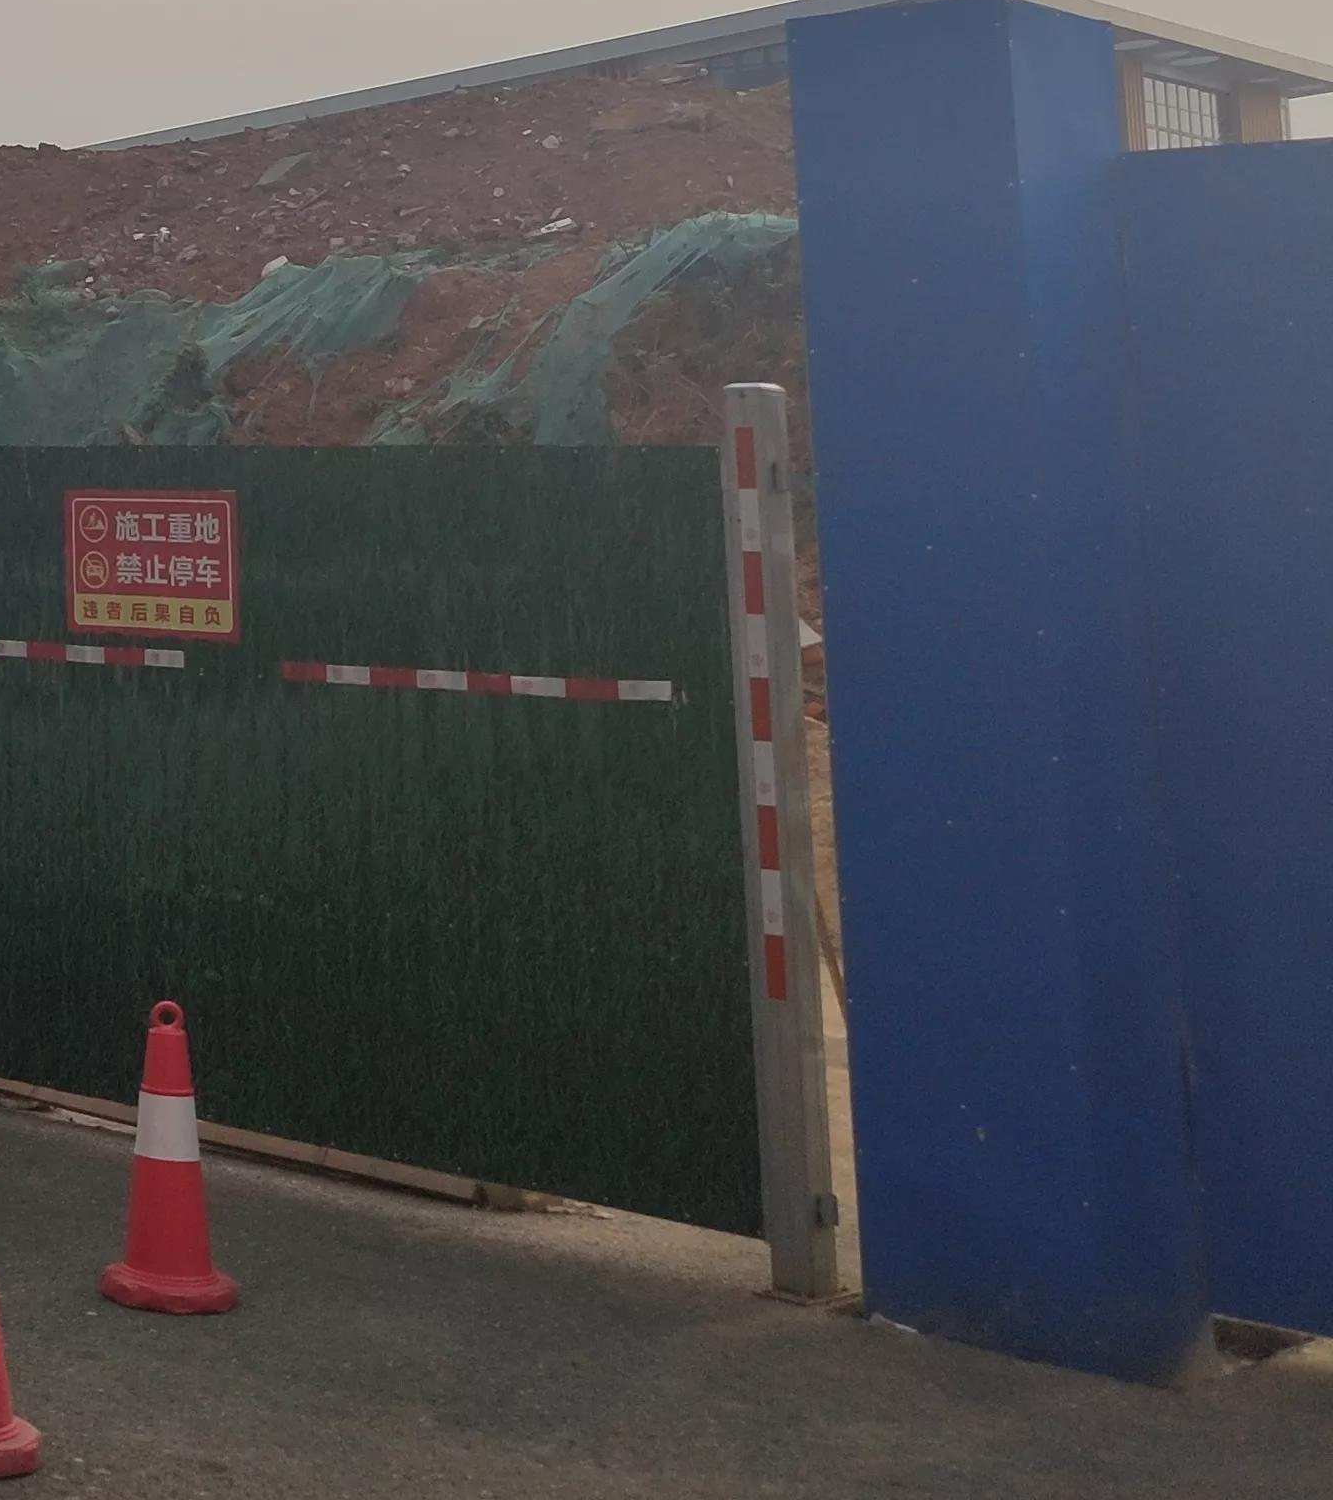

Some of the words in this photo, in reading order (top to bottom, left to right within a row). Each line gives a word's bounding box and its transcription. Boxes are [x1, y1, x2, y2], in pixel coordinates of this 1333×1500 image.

[115, 510, 221, 544] 施工重地
[116, 552, 222, 589] 禁止停车
[82, 600, 221, 626] 违者后果自负
